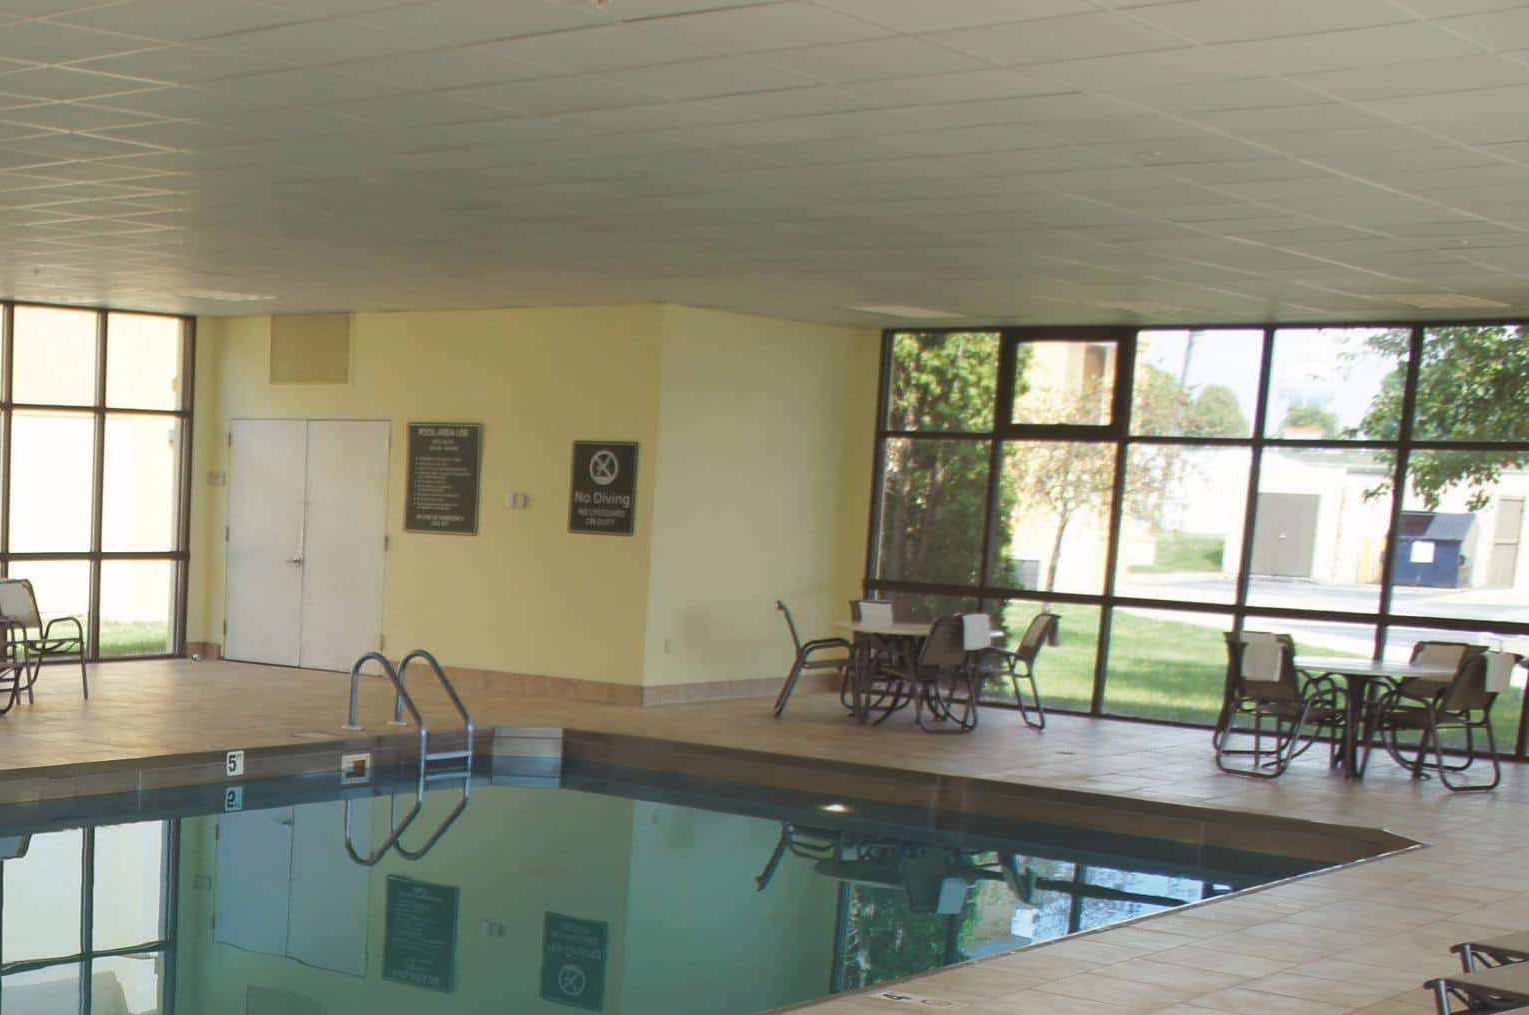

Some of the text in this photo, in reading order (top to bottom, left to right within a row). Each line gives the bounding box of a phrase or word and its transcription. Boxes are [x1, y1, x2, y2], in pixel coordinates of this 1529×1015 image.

[574, 491, 631, 509] No Diving
[228, 754, 237, 772] 5
